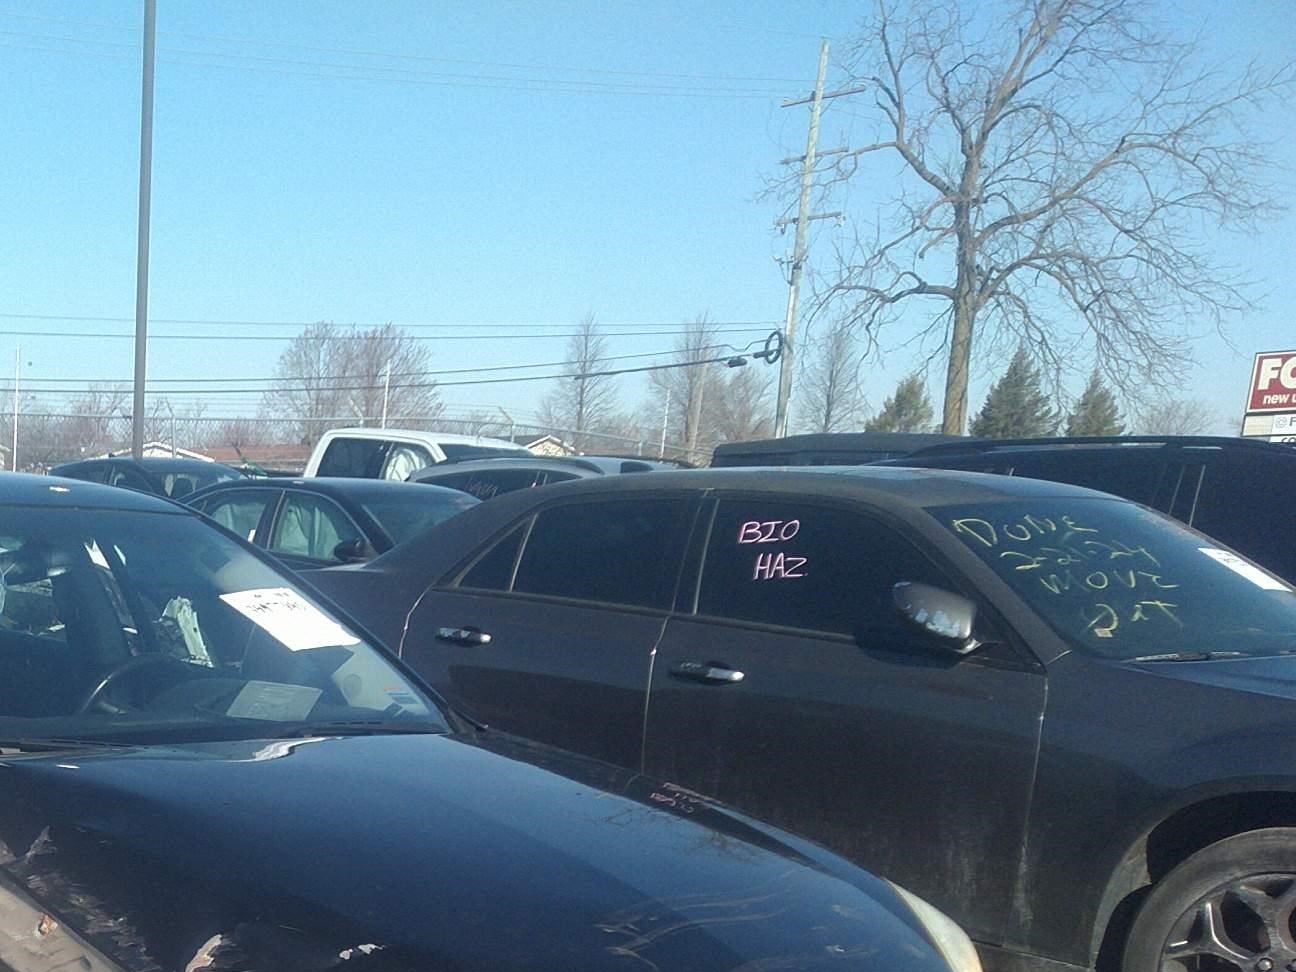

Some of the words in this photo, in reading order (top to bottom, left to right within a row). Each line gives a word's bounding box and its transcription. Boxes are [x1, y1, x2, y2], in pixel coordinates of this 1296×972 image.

[1263, 394, 1290, 405] new
[738, 519, 800, 544] BIO
[1039, 570, 1180, 594] MOVE
